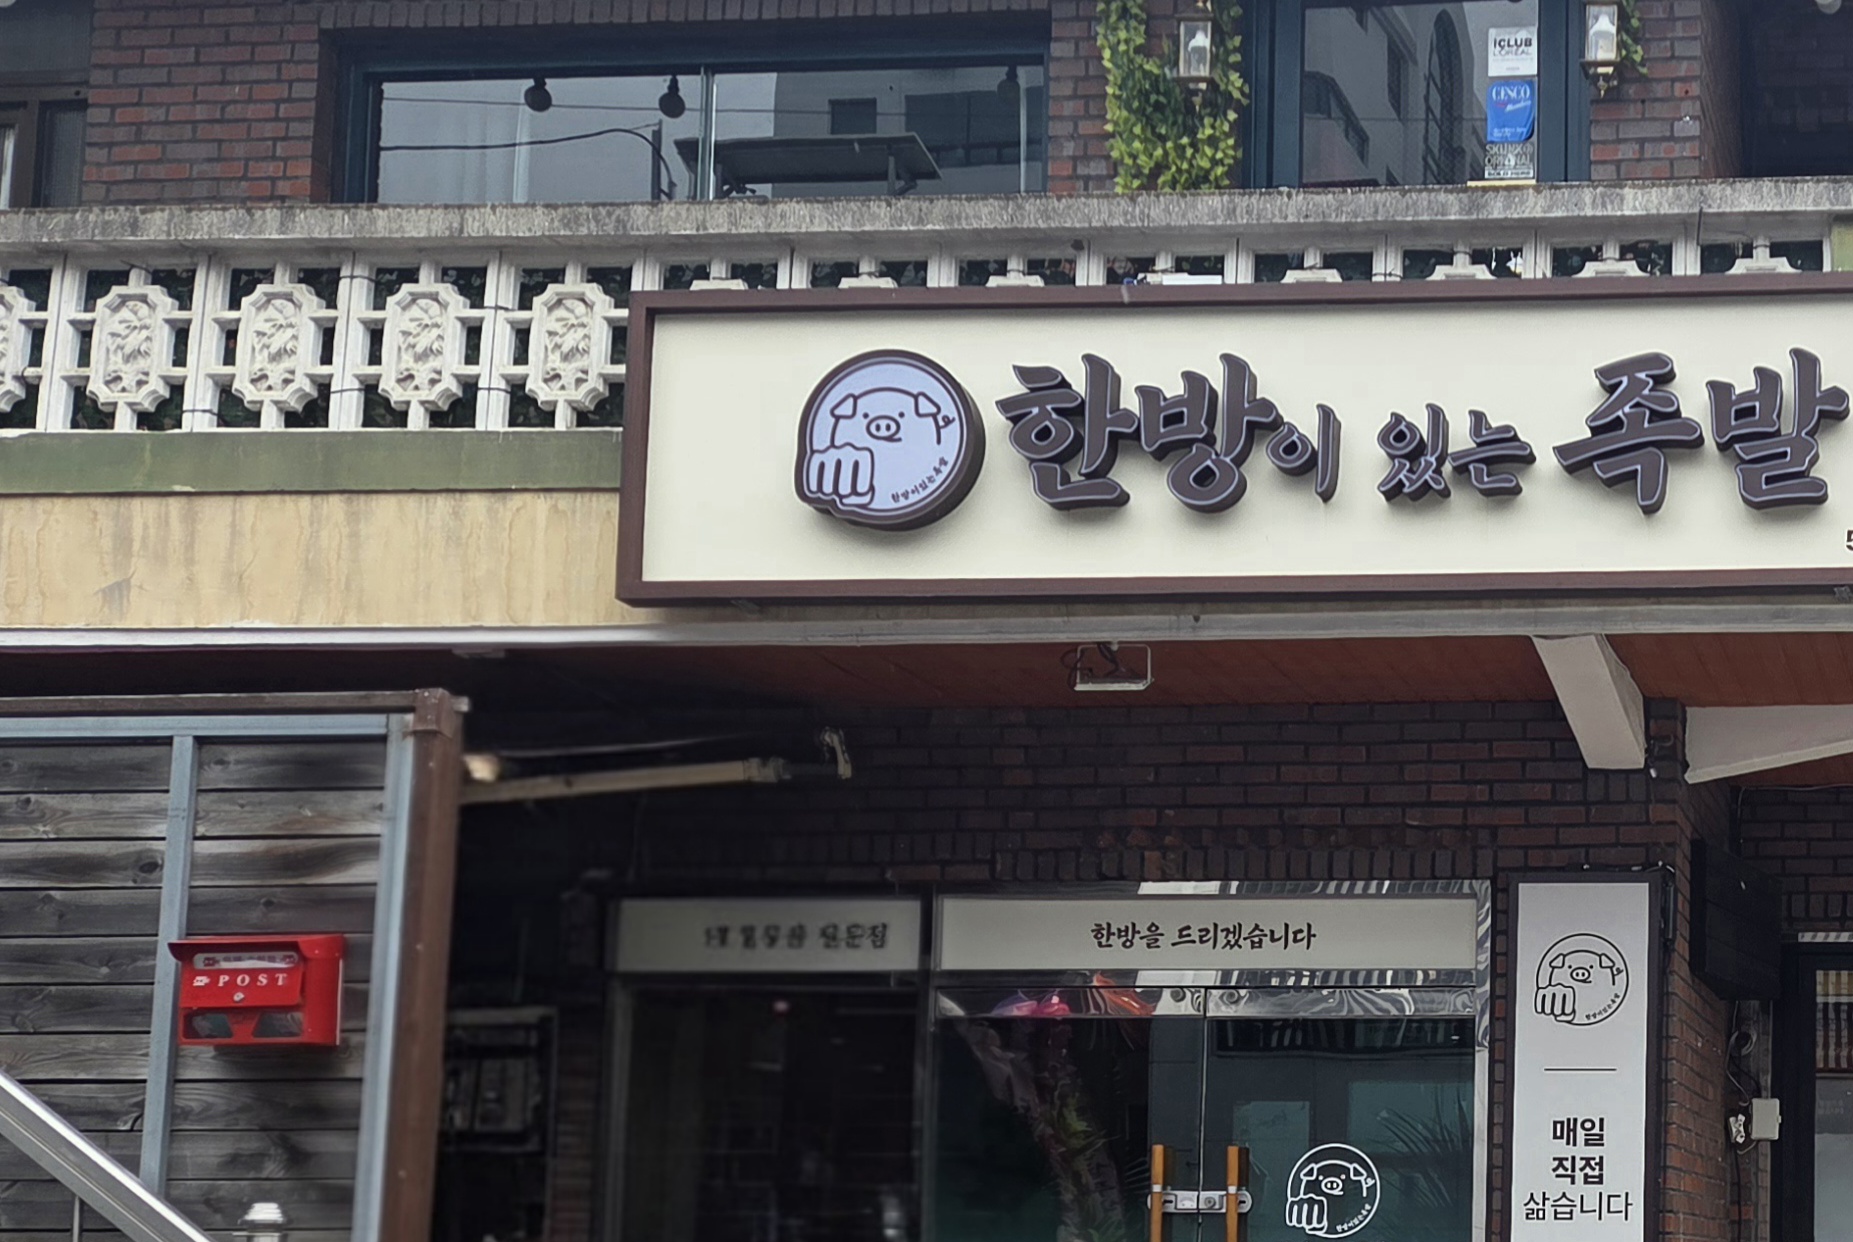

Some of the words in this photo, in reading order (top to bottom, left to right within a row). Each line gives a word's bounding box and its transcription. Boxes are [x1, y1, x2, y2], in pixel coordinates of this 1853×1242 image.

[996, 352, 1344, 513] 한방이
[1374, 402, 1537, 502] 있는
[1551, 347, 1851, 516] 족발
[1090, 921, 1165, 949] 한방을
[1171, 921, 1317, 950] 드리겠습니다
[217, 973, 288, 987] POST
[1552, 1117, 1605, 1147] 매일
[1551, 1155, 1605, 1185] 직접
[1522, 1190, 1633, 1222] 삶습니다
